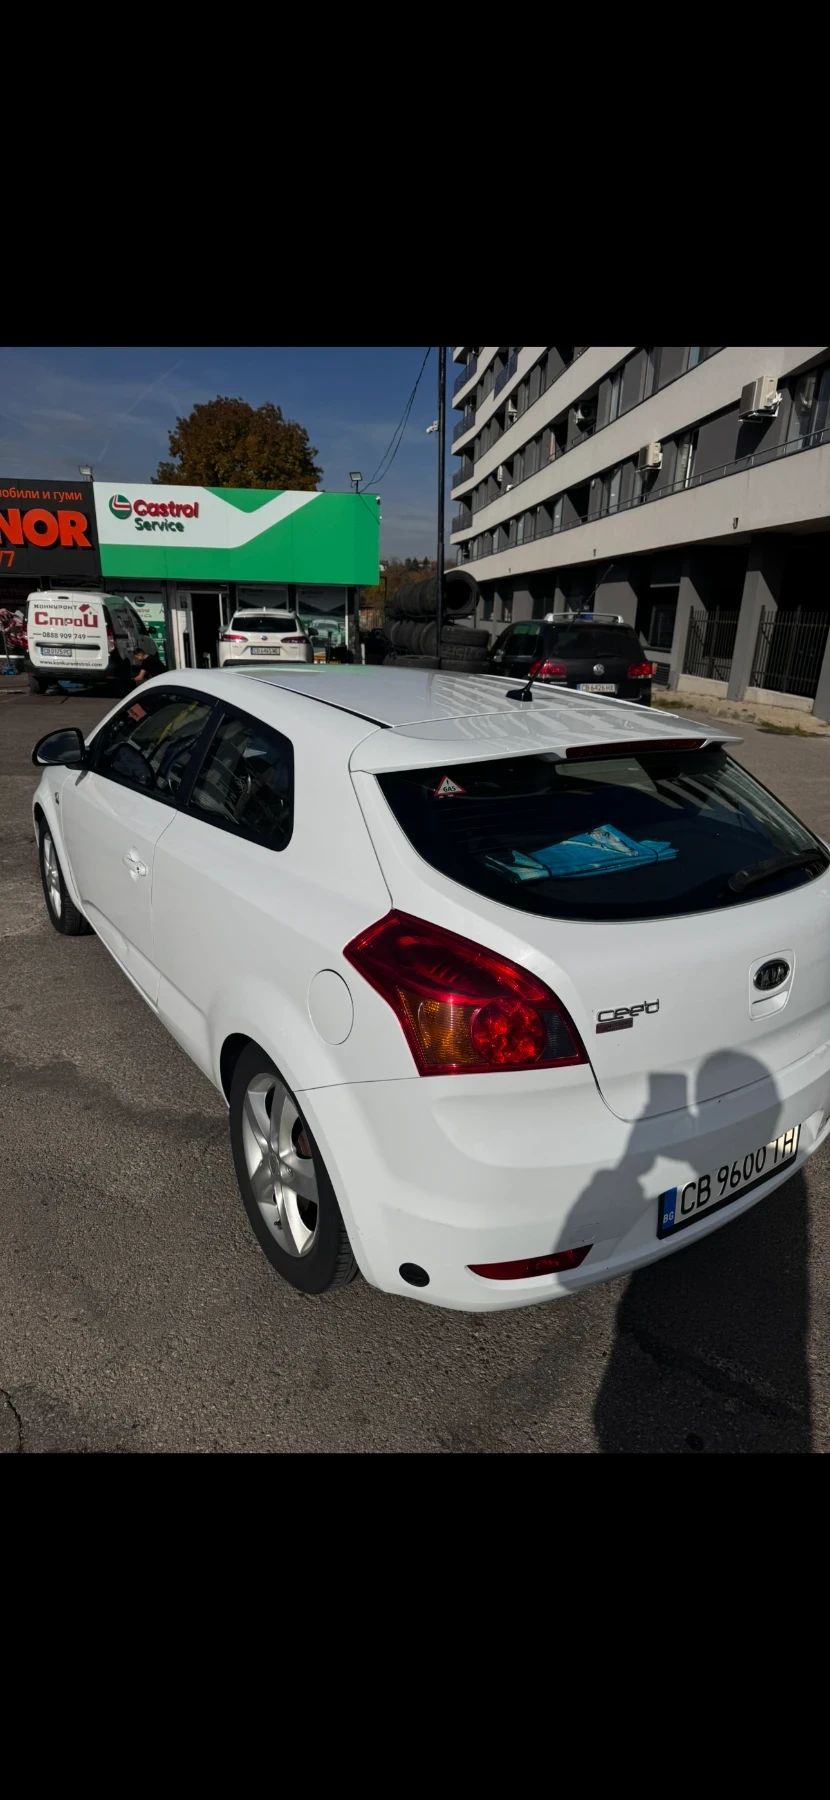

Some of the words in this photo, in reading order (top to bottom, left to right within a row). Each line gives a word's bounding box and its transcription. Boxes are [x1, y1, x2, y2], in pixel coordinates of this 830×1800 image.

[42, 490, 51, 500] и
[53, 490, 83, 503] гуми
[133, 499, 199, 519] Castrol
[134, 517, 185, 533] Service
[680, 1174, 711, 1215] CB
[717, 1146, 767, 1197] 9600
[662, 1210, 675, 1224] BG
